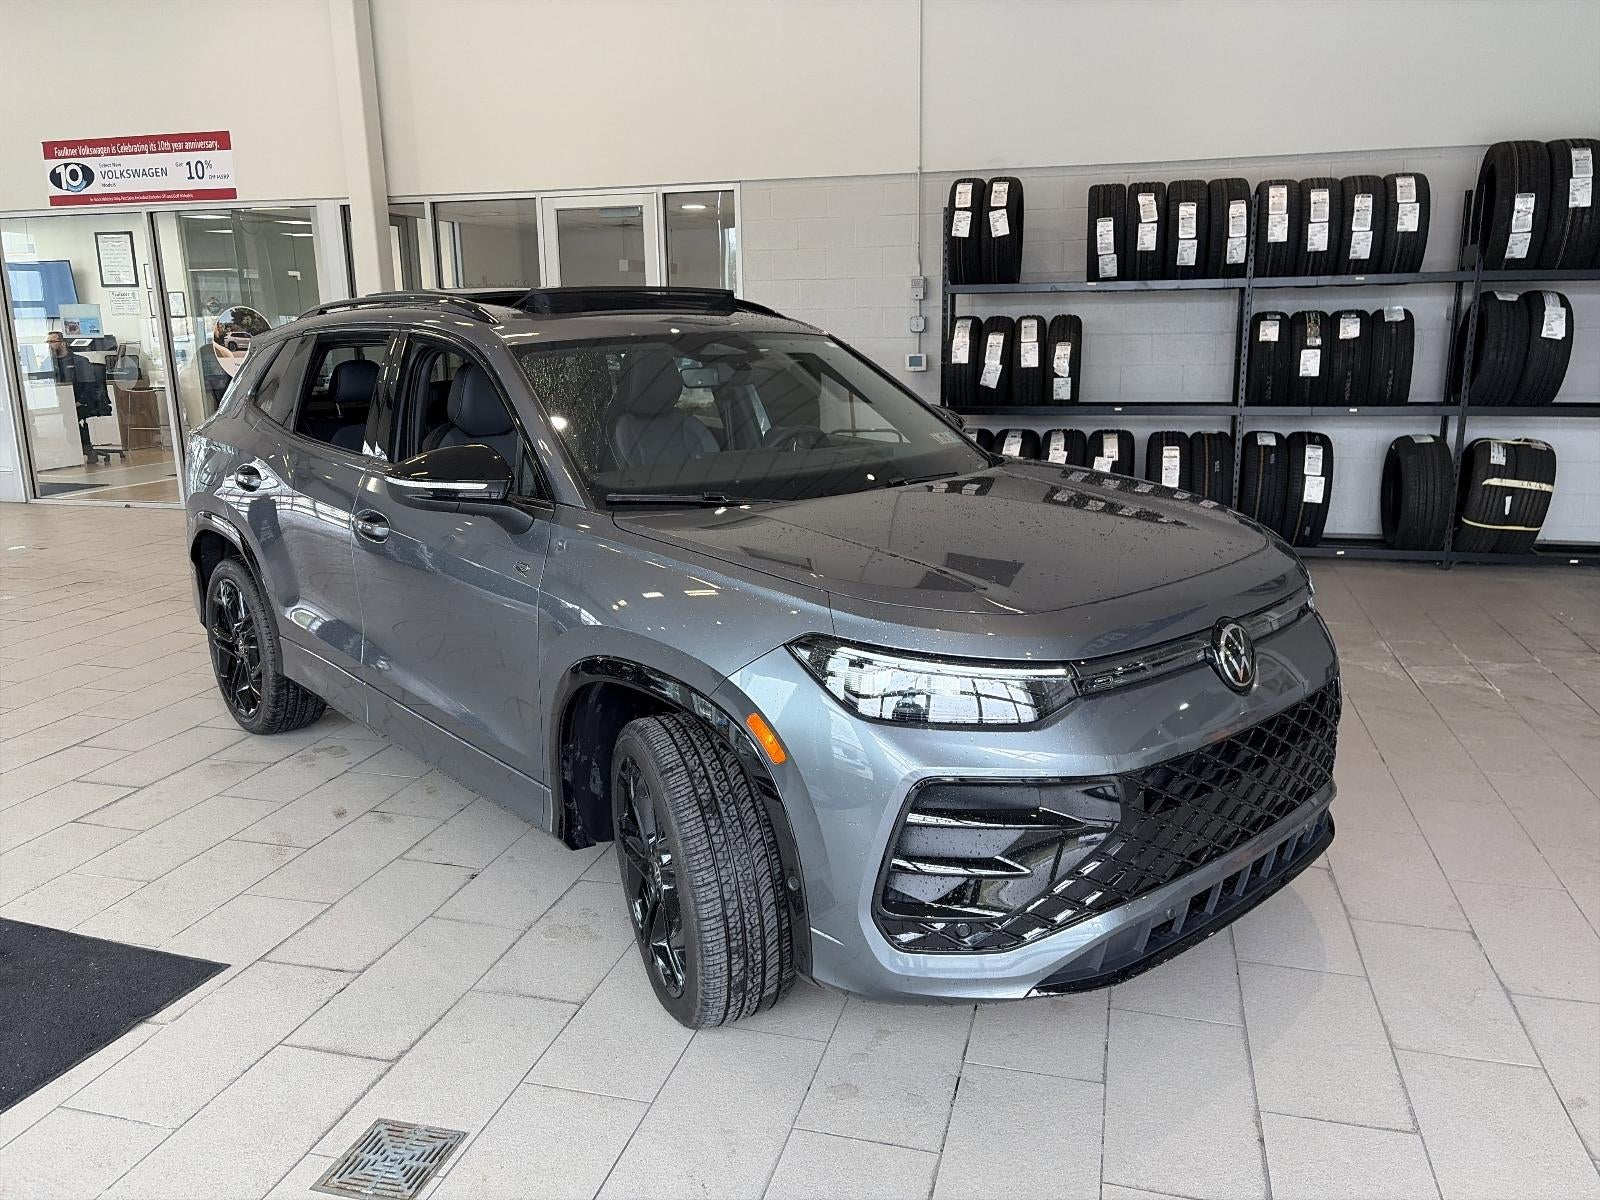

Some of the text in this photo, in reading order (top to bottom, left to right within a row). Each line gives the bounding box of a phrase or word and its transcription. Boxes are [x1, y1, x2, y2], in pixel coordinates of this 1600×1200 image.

[54, 146, 78, 157] Faulkner
[77, 145, 111, 156] Volkswagen
[110, 143, 117, 154] is
[116, 142, 149, 154] Celebrating
[157, 140, 171, 151] 10th
[171, 140, 184, 152] year
[55, 164, 83, 190] 10
[99, 167, 168, 179] VOLKSWAGEN
